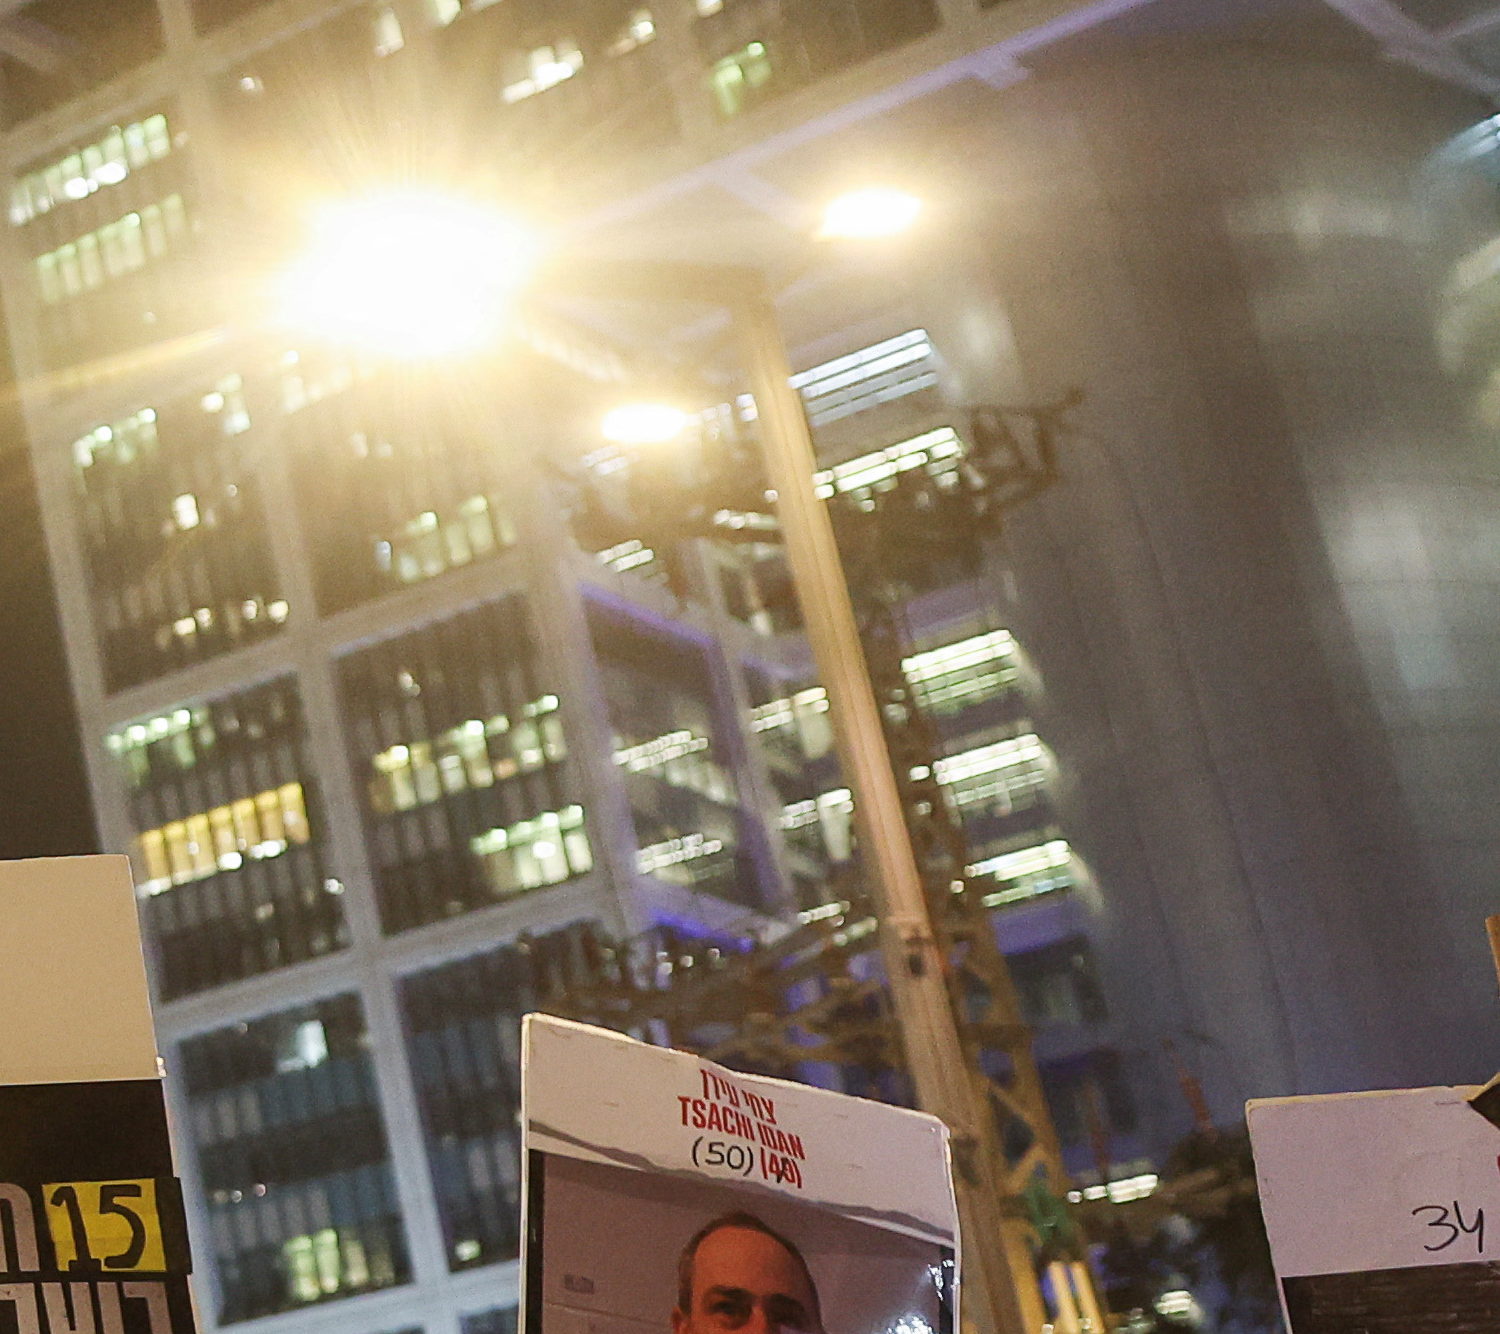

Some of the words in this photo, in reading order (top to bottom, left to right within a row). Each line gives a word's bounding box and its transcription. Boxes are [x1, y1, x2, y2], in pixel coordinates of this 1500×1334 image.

[677, 1095, 755, 1142] TSACHI
[757, 1121, 805, 1160] IDAN
[691, 1135, 754, 1177] (50)
[51, 1185, 147, 1270] 15
[1411, 1200, 1484, 1253] 34
